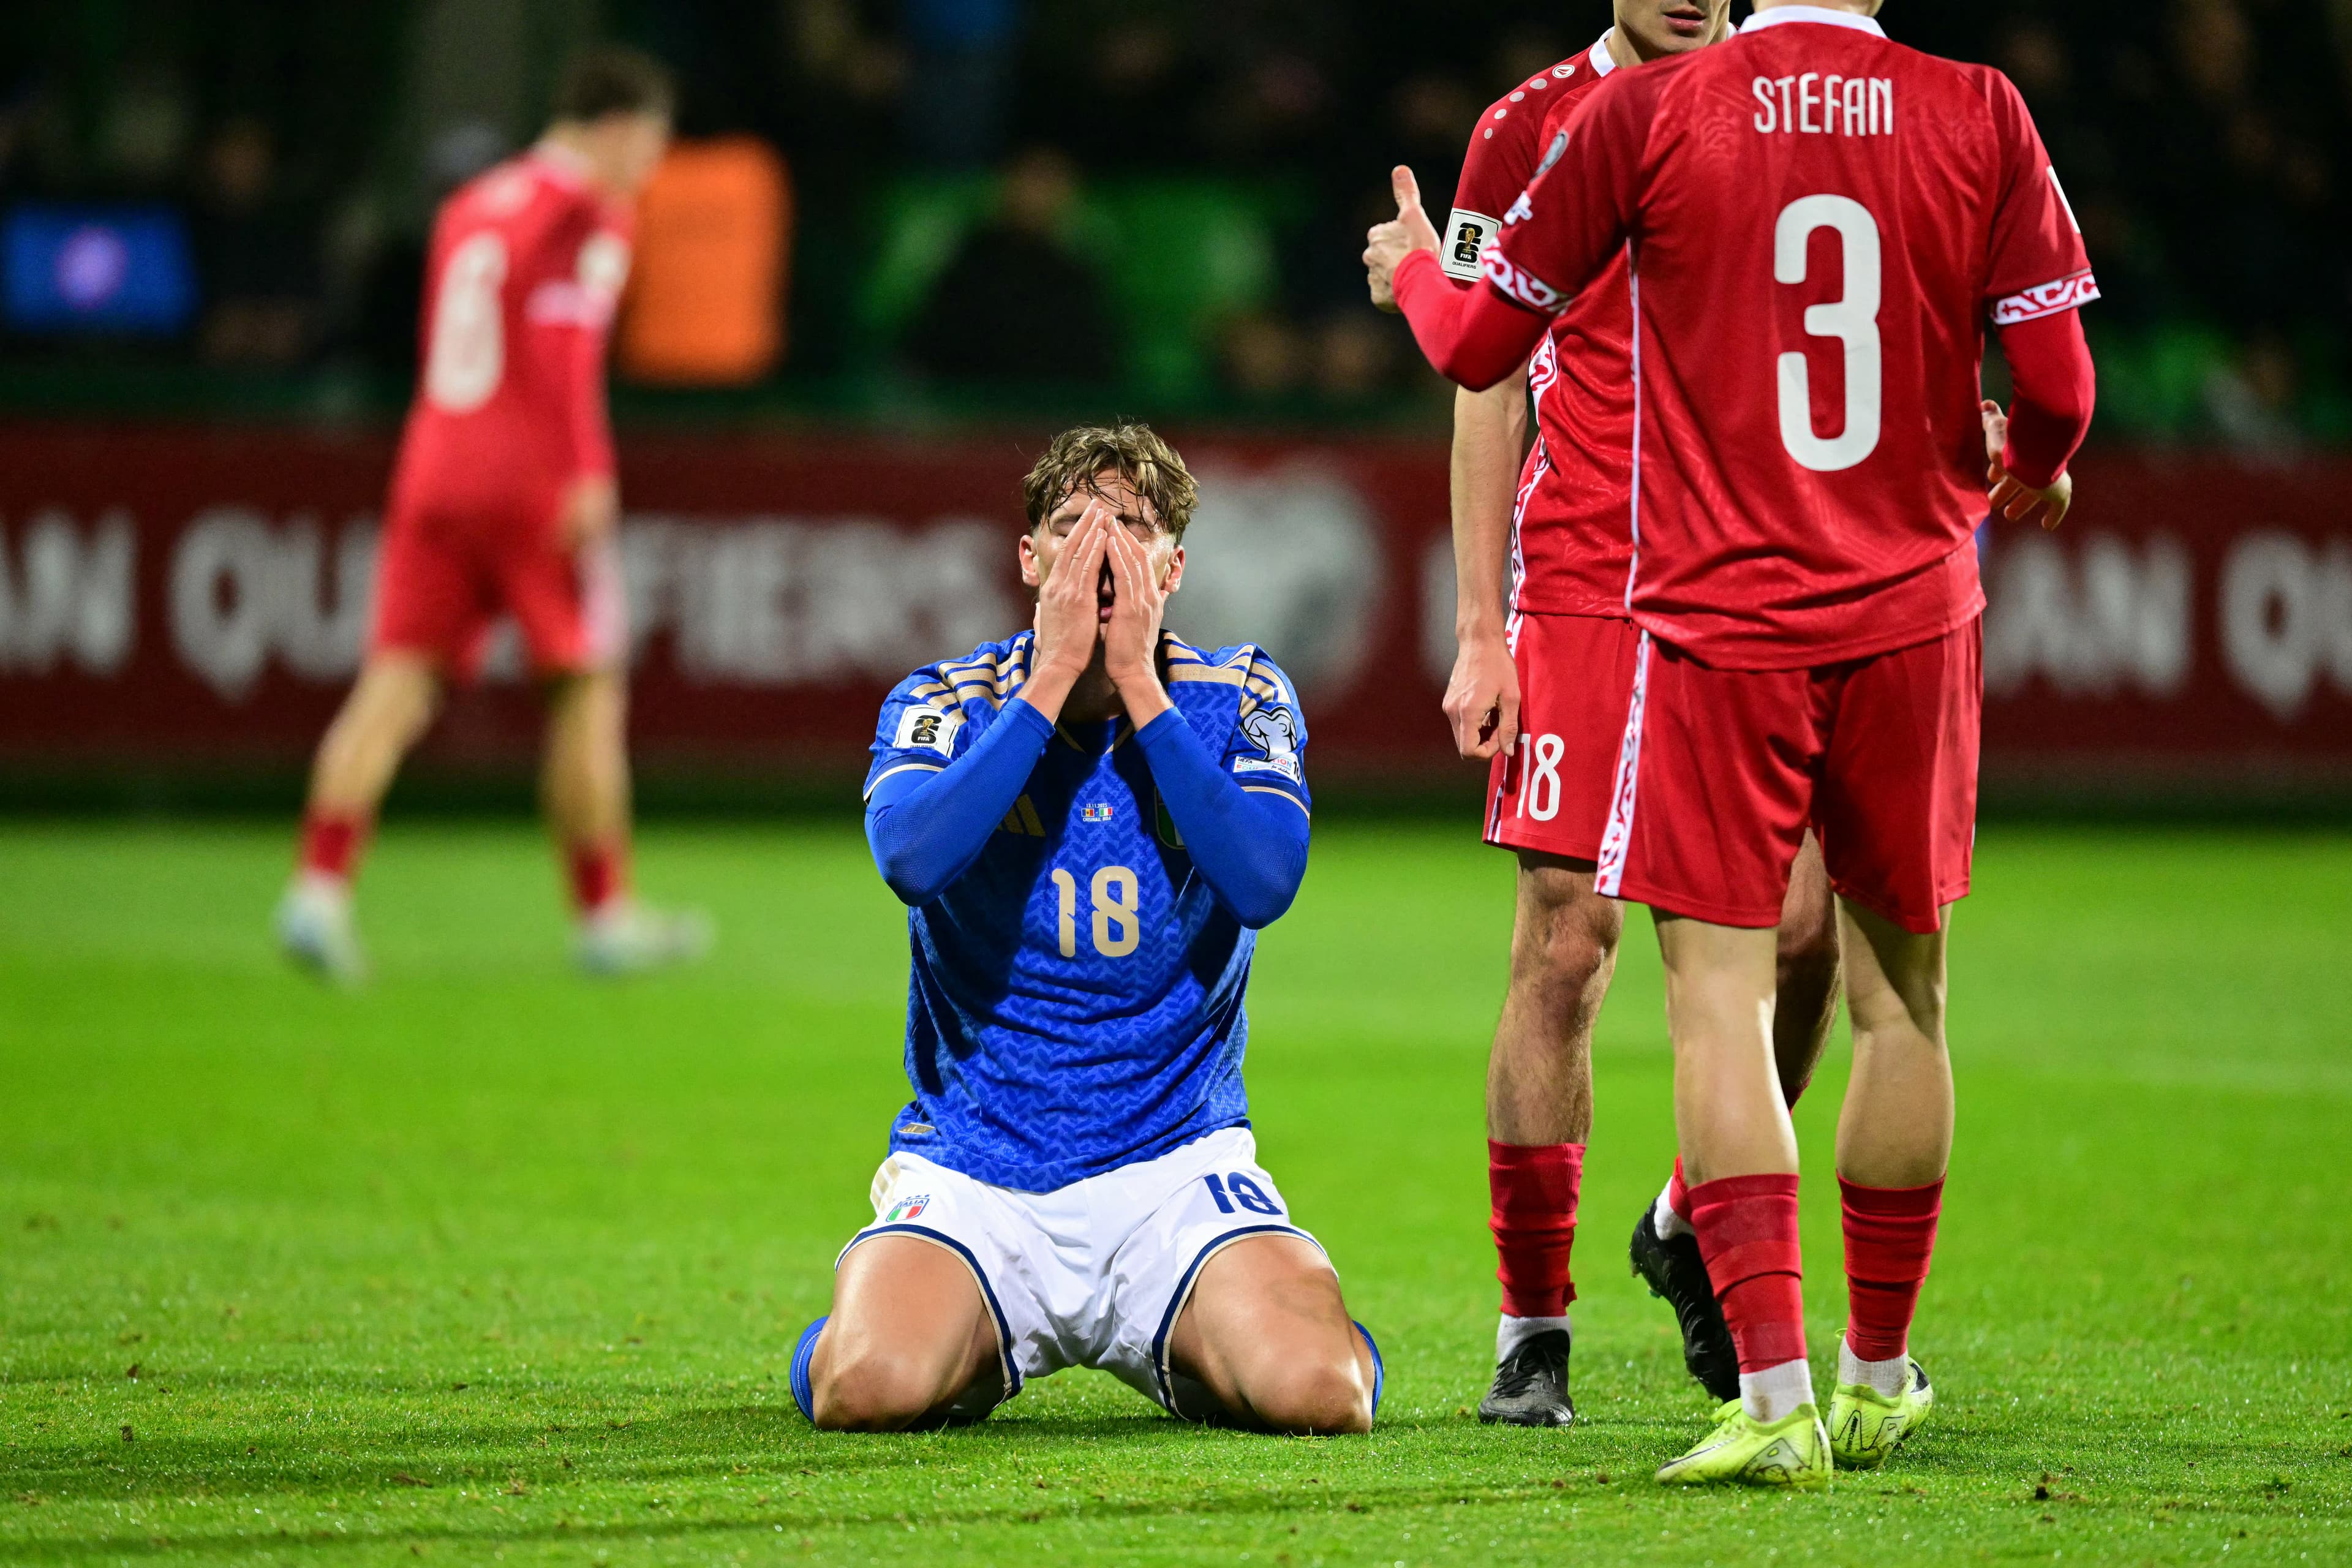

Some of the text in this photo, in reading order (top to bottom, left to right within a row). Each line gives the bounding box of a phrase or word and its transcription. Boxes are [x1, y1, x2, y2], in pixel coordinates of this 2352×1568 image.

[1752, 72, 1893, 137] STEFAN
[1773, 194, 1882, 472] 3
[1517, 734, 1564, 821] 18
[1052, 865, 1139, 957] 18
[895, 1200, 924, 1209] ITALIA
